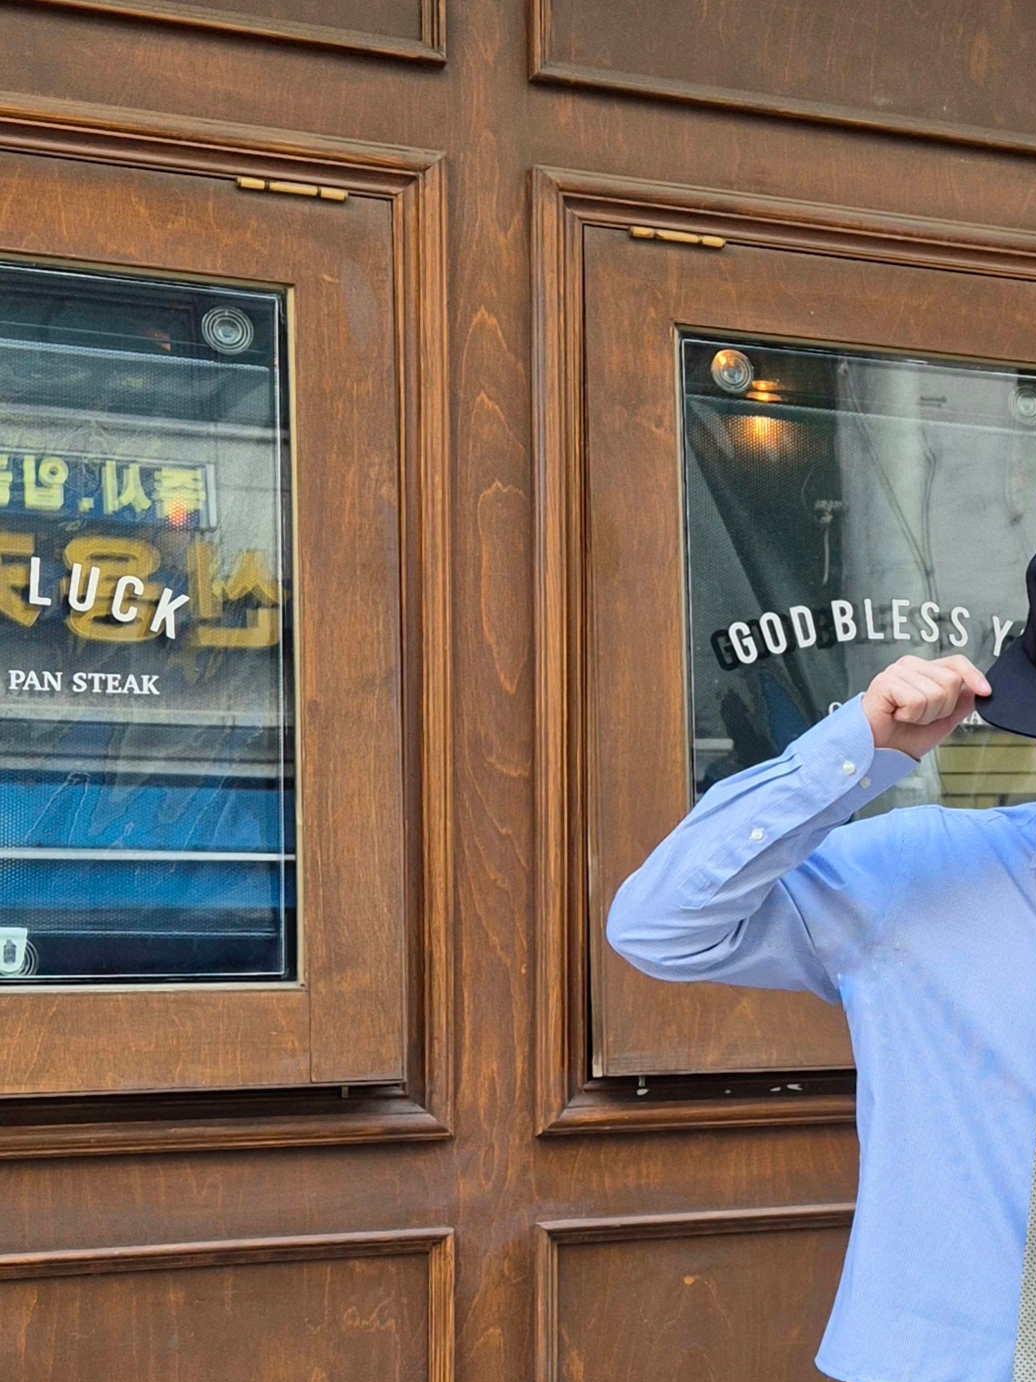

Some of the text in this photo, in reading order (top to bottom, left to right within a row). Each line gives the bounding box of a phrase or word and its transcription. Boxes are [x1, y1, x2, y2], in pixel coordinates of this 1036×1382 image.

[28, 556, 191, 640] LUCK
[728, 604, 817, 665] GOD
[831, 598, 971, 648] BLESS
[8, 669, 161, 697] PAN STEAK
